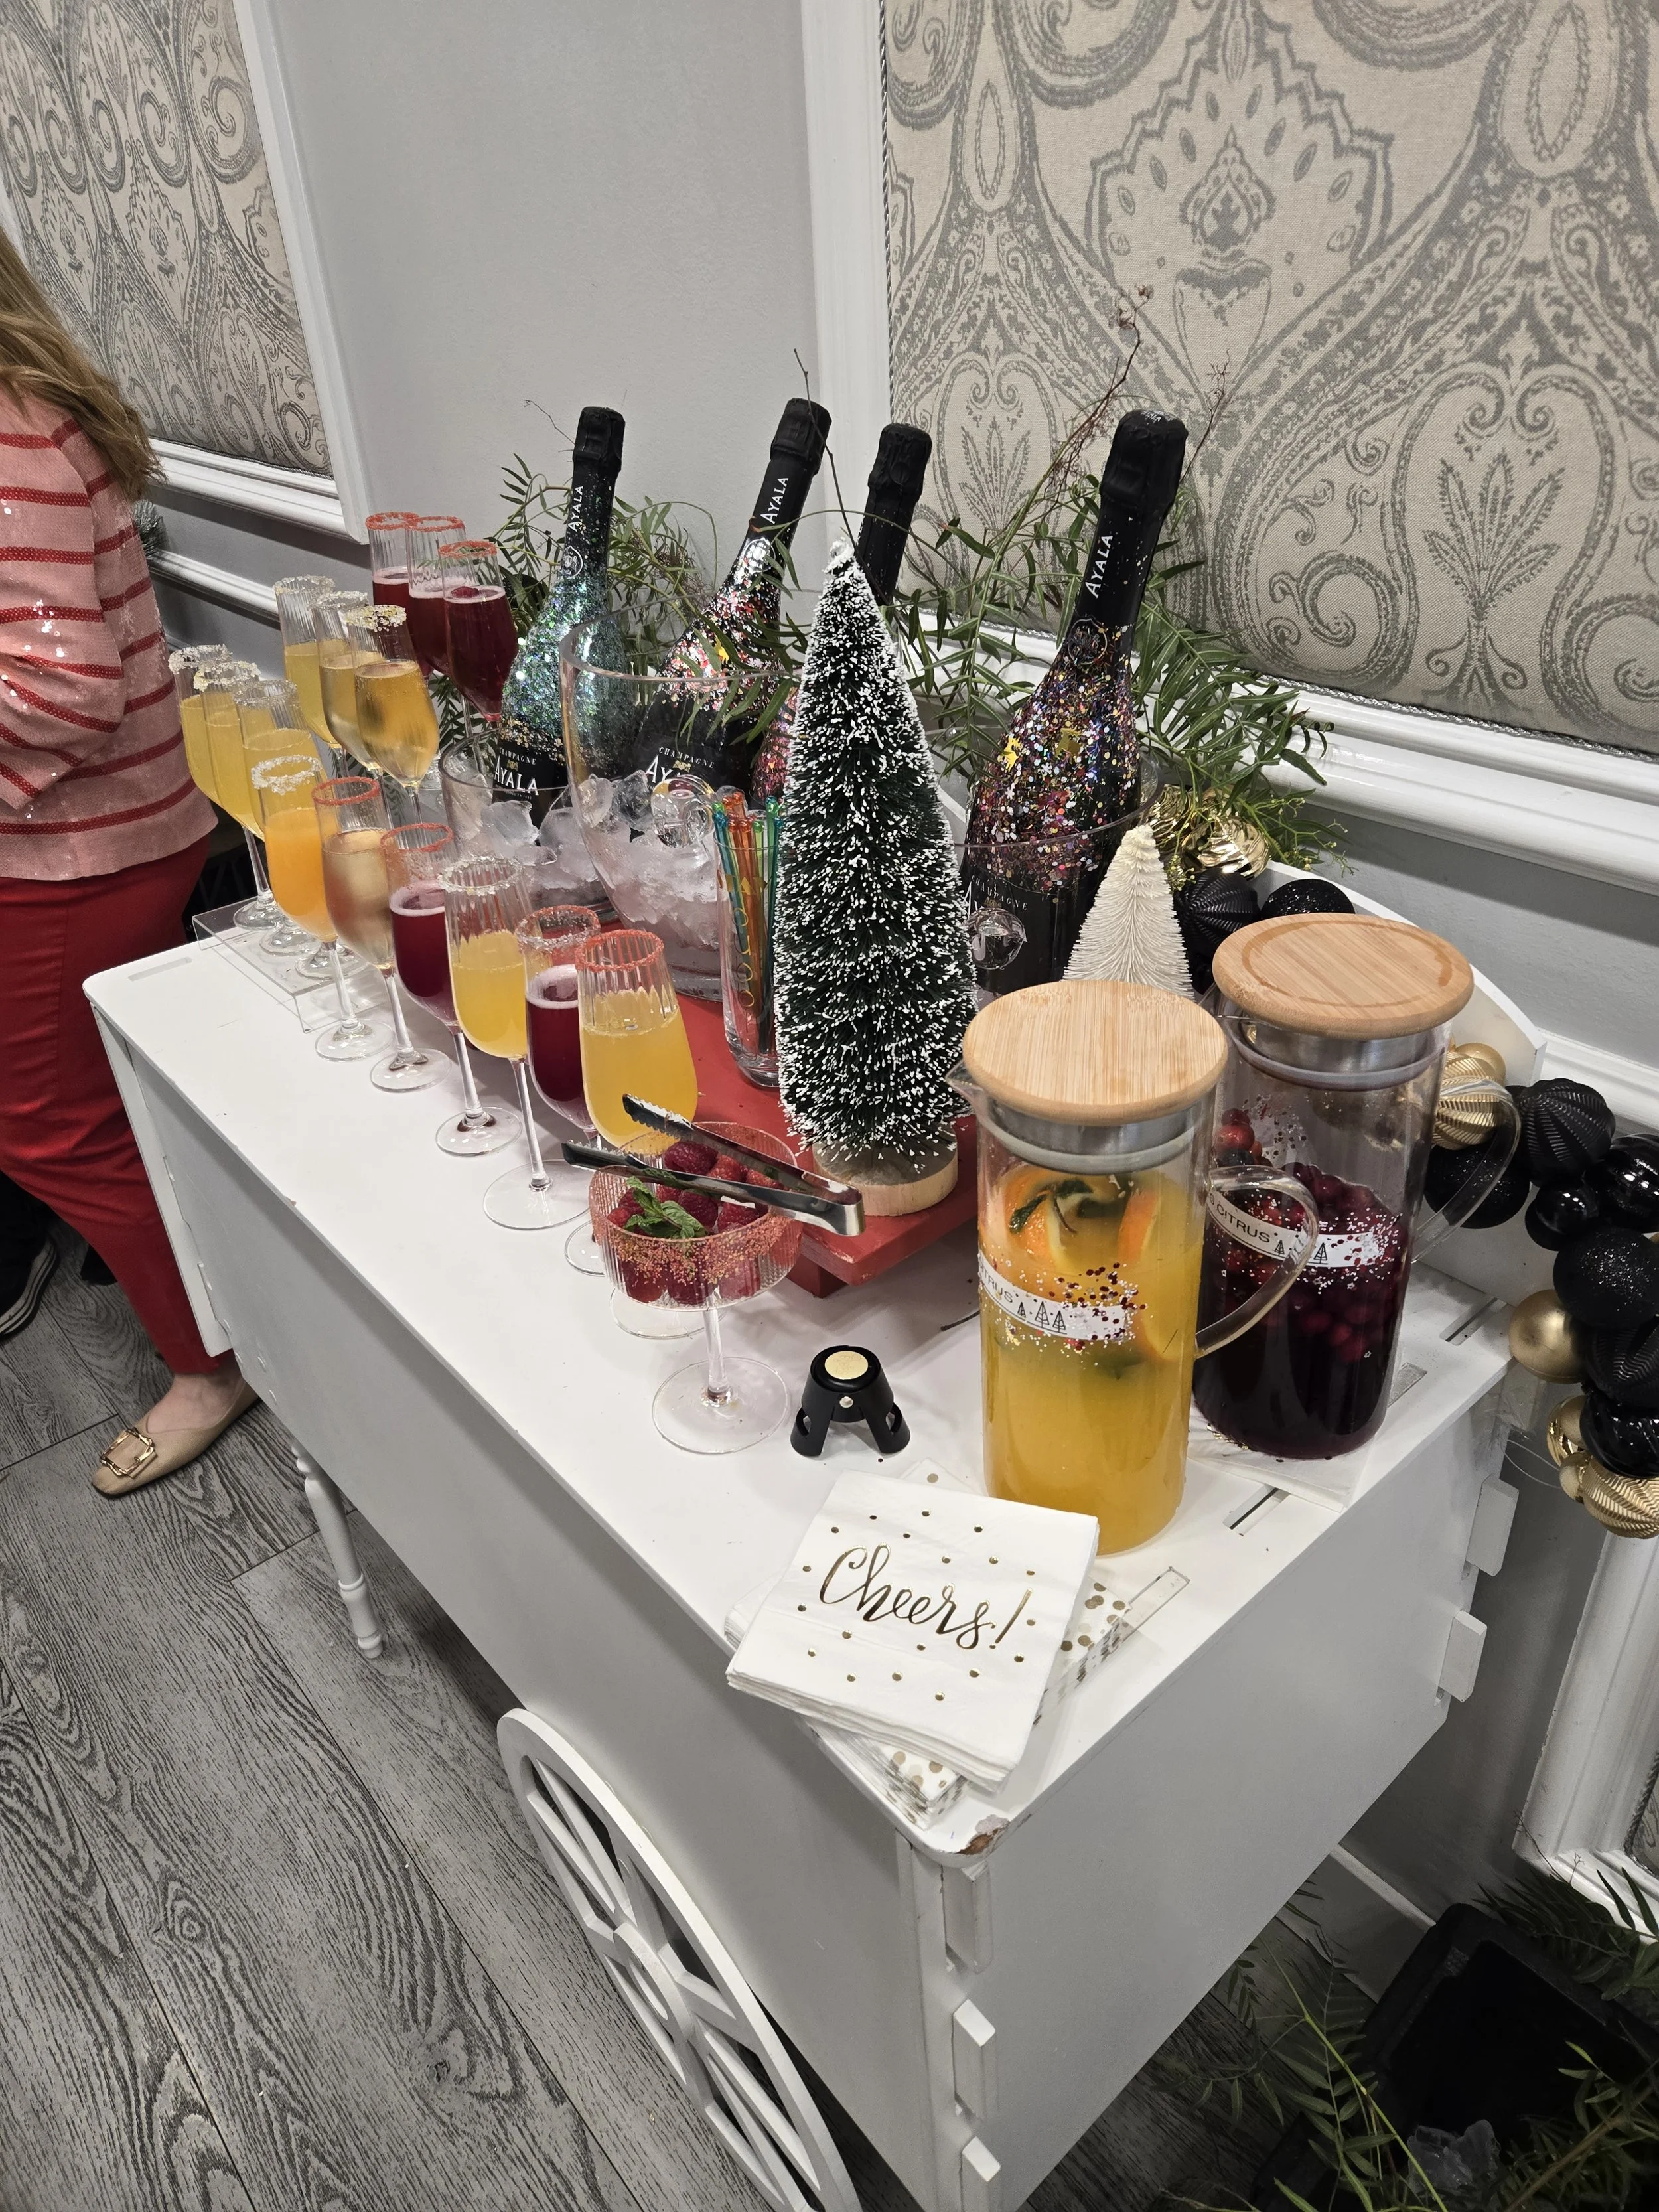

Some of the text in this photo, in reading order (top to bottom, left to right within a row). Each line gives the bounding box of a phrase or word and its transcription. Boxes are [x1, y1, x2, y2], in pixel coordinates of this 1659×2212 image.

[567, 485, 584, 532] AYALA
[760, 477, 789, 525] AYALA
[1084, 535, 1114, 599] AYALA
[494, 755, 540, 796] AYALA
[658, 746, 715, 769] CHAMPAGNE
[1216, 1203, 1271, 1244] CITRUS
[979, 1263, 1013, 1303] TRUS
[819, 1541, 1035, 1651] Cheers!
